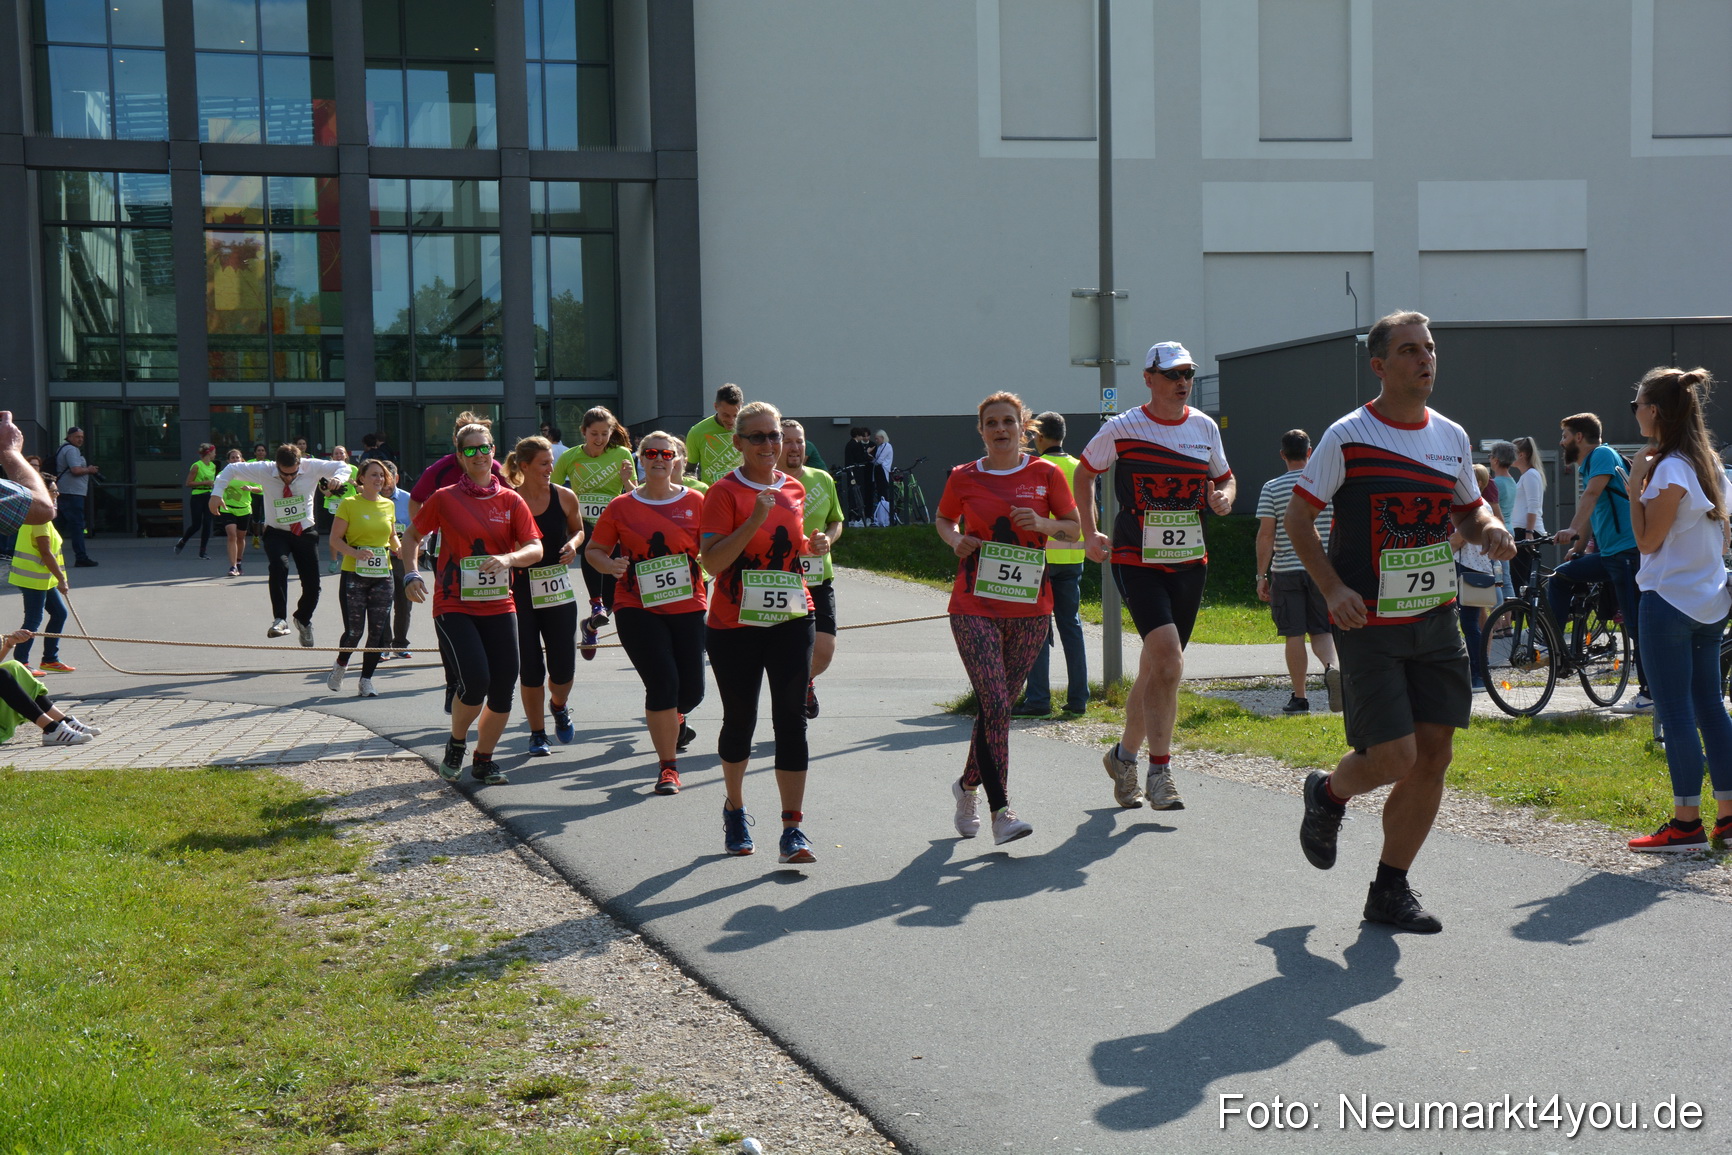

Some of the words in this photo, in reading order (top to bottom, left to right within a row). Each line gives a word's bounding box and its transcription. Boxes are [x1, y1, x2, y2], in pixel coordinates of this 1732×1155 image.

[1425, 454, 1457, 462] NEUMARKT
[284, 506, 297, 515] 90
[1148, 512, 1198, 525] BOCK
[1162, 529, 1186, 546] 82
[986, 543, 1040, 564] BOCK
[1155, 549, 1193, 558] JÜRGEN
[1385, 545, 1450, 569] BOCK
[367, 557, 382, 567] 68
[640, 555, 684, 574] BOCK
[478, 571, 496, 586] 53
[532, 566, 566, 579] BOCK
[997, 563, 1022, 583] 54
[541, 577, 565, 593] 101
[654, 571, 677, 589] 56
[747, 572, 800, 588] BOCK
[1406, 570, 1435, 594] 79
[473, 588, 501, 596] SABINE
[653, 588, 684, 600] NICOLE
[986, 583, 1028, 597] KORONA
[543, 593, 567, 603] SONJA
[762, 590, 788, 608] 55
[1396, 596, 1441, 610] RAINER
[757, 612, 790, 621] TANJA
